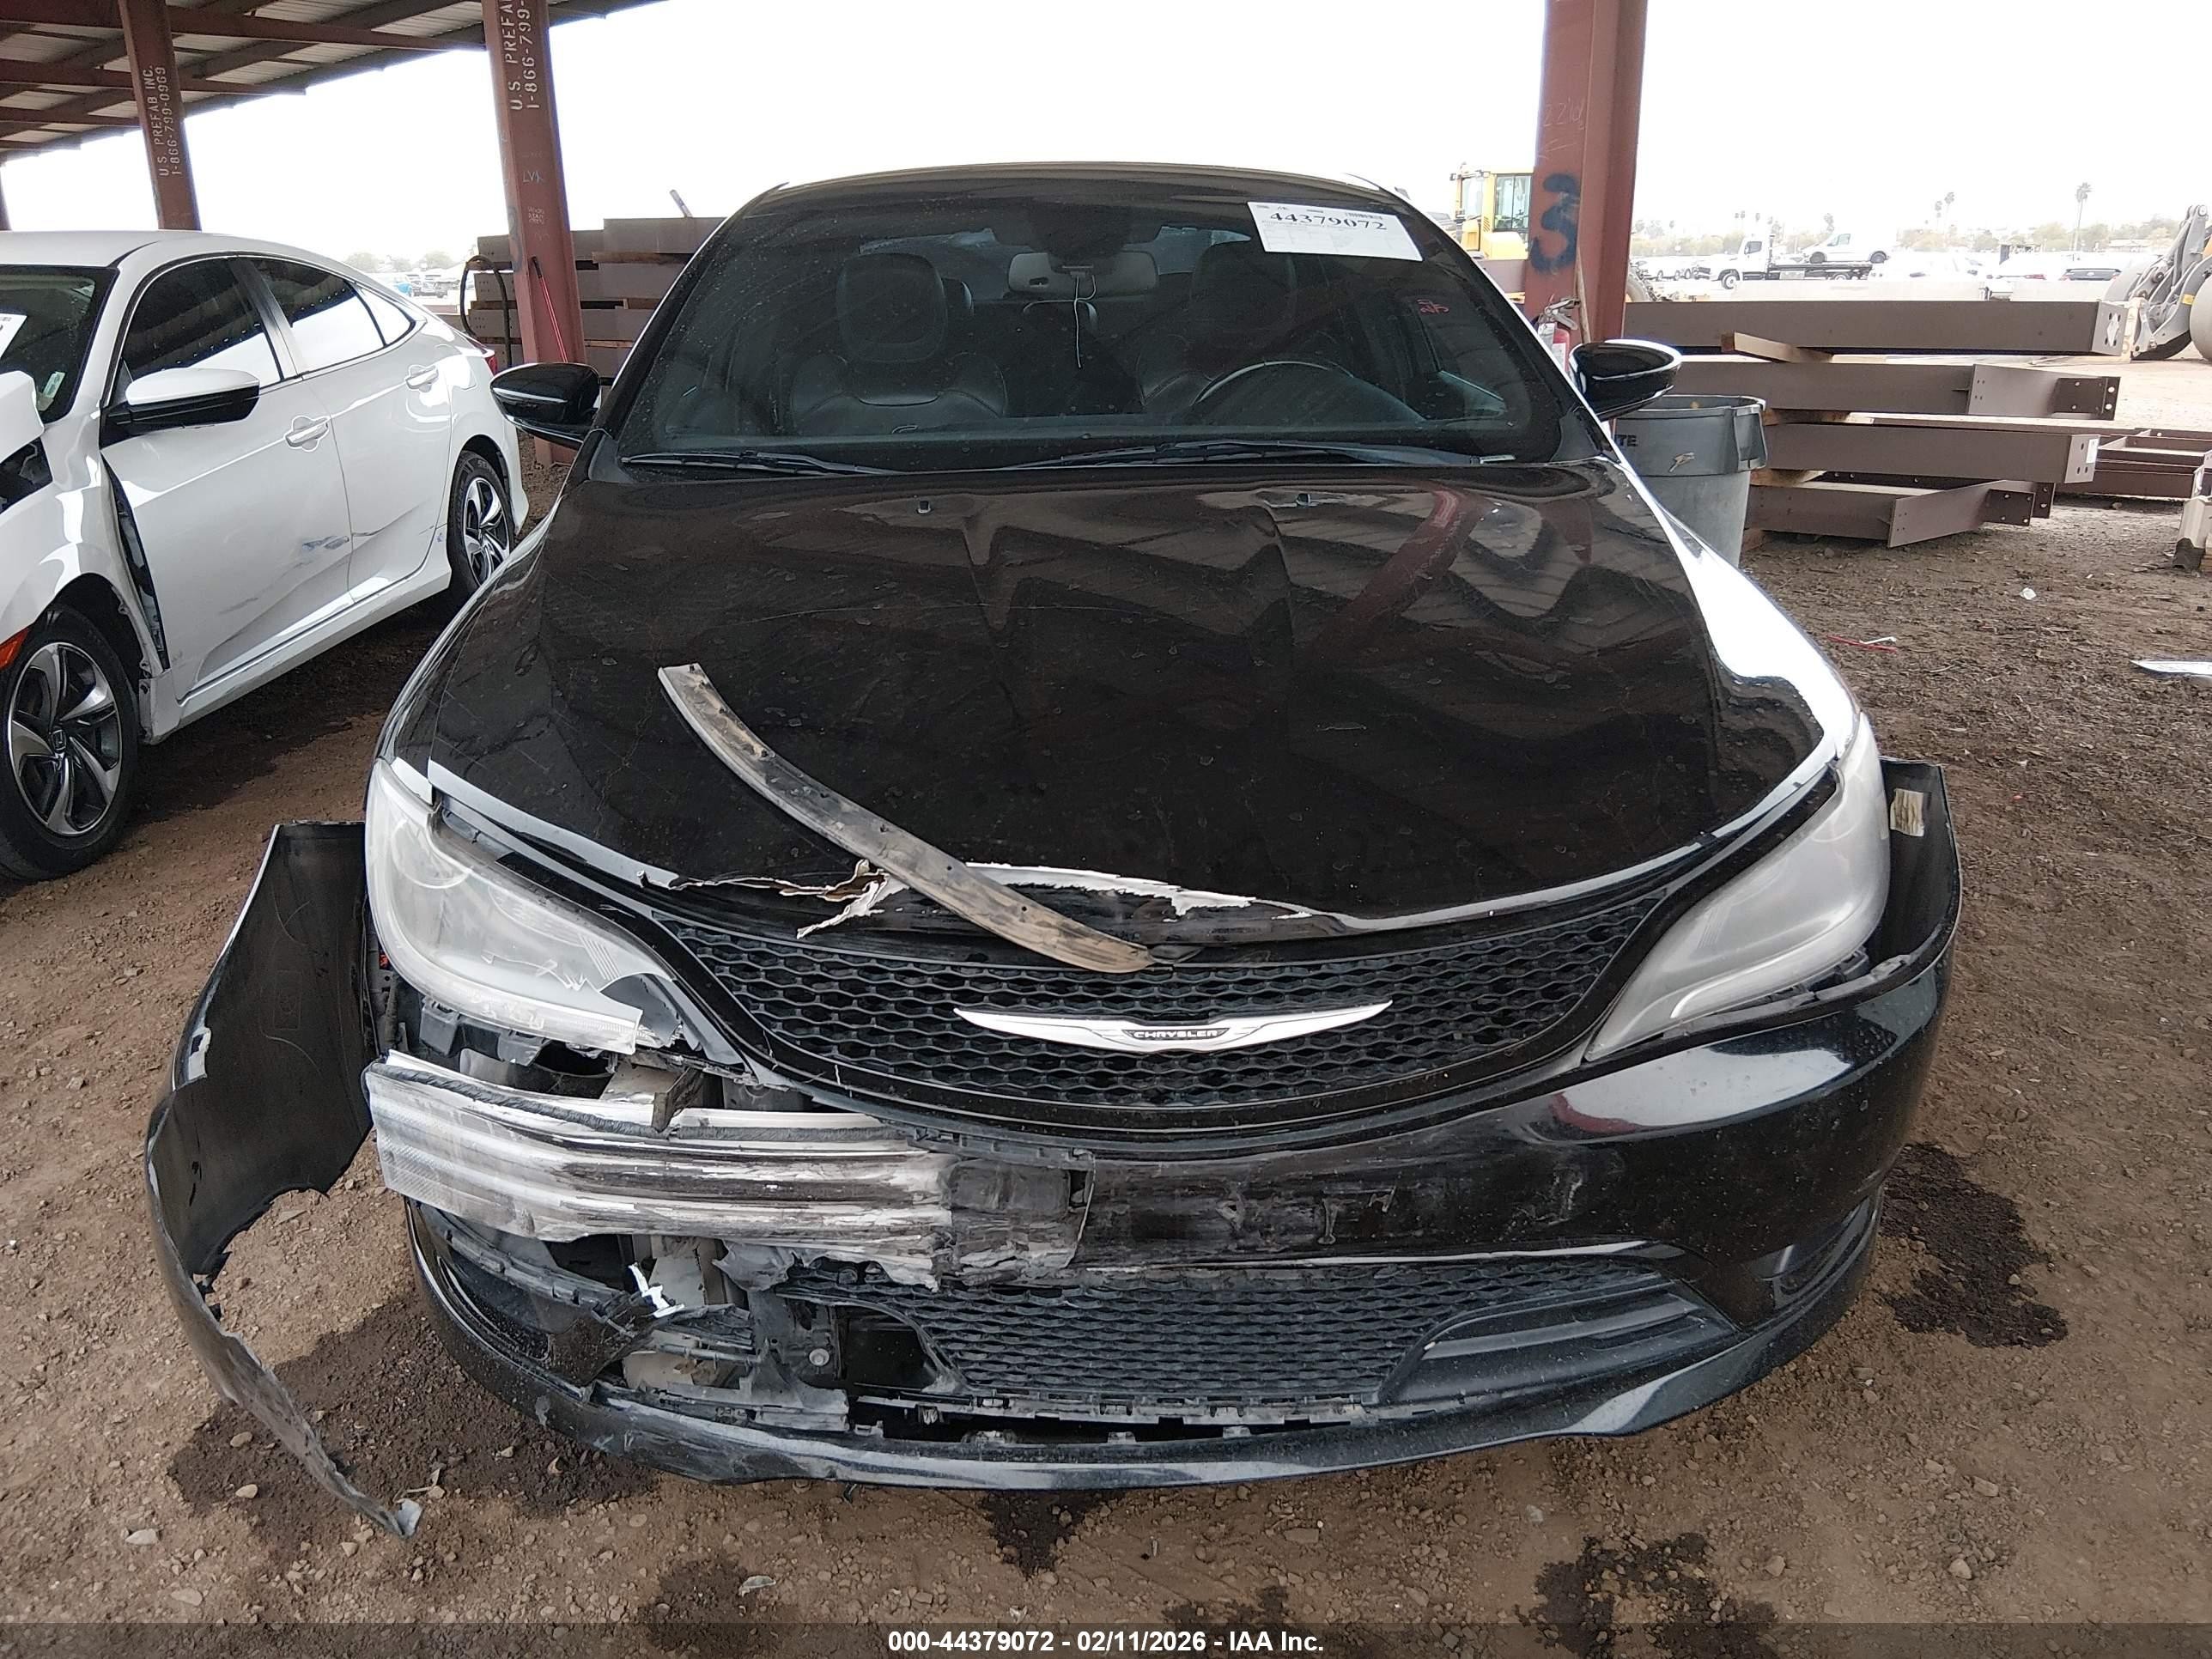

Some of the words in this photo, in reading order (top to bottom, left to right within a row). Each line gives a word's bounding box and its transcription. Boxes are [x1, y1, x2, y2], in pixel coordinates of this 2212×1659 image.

[500, 0, 518, 64] PREFA
[143, 65, 156, 89] INC.
[147, 96, 166, 145] PREFAB
[155, 67, 182, 175] 1-866-799-0969
[1270, 212, 1387, 230] 44379072
[1529, 173, 1582, 276] 3
